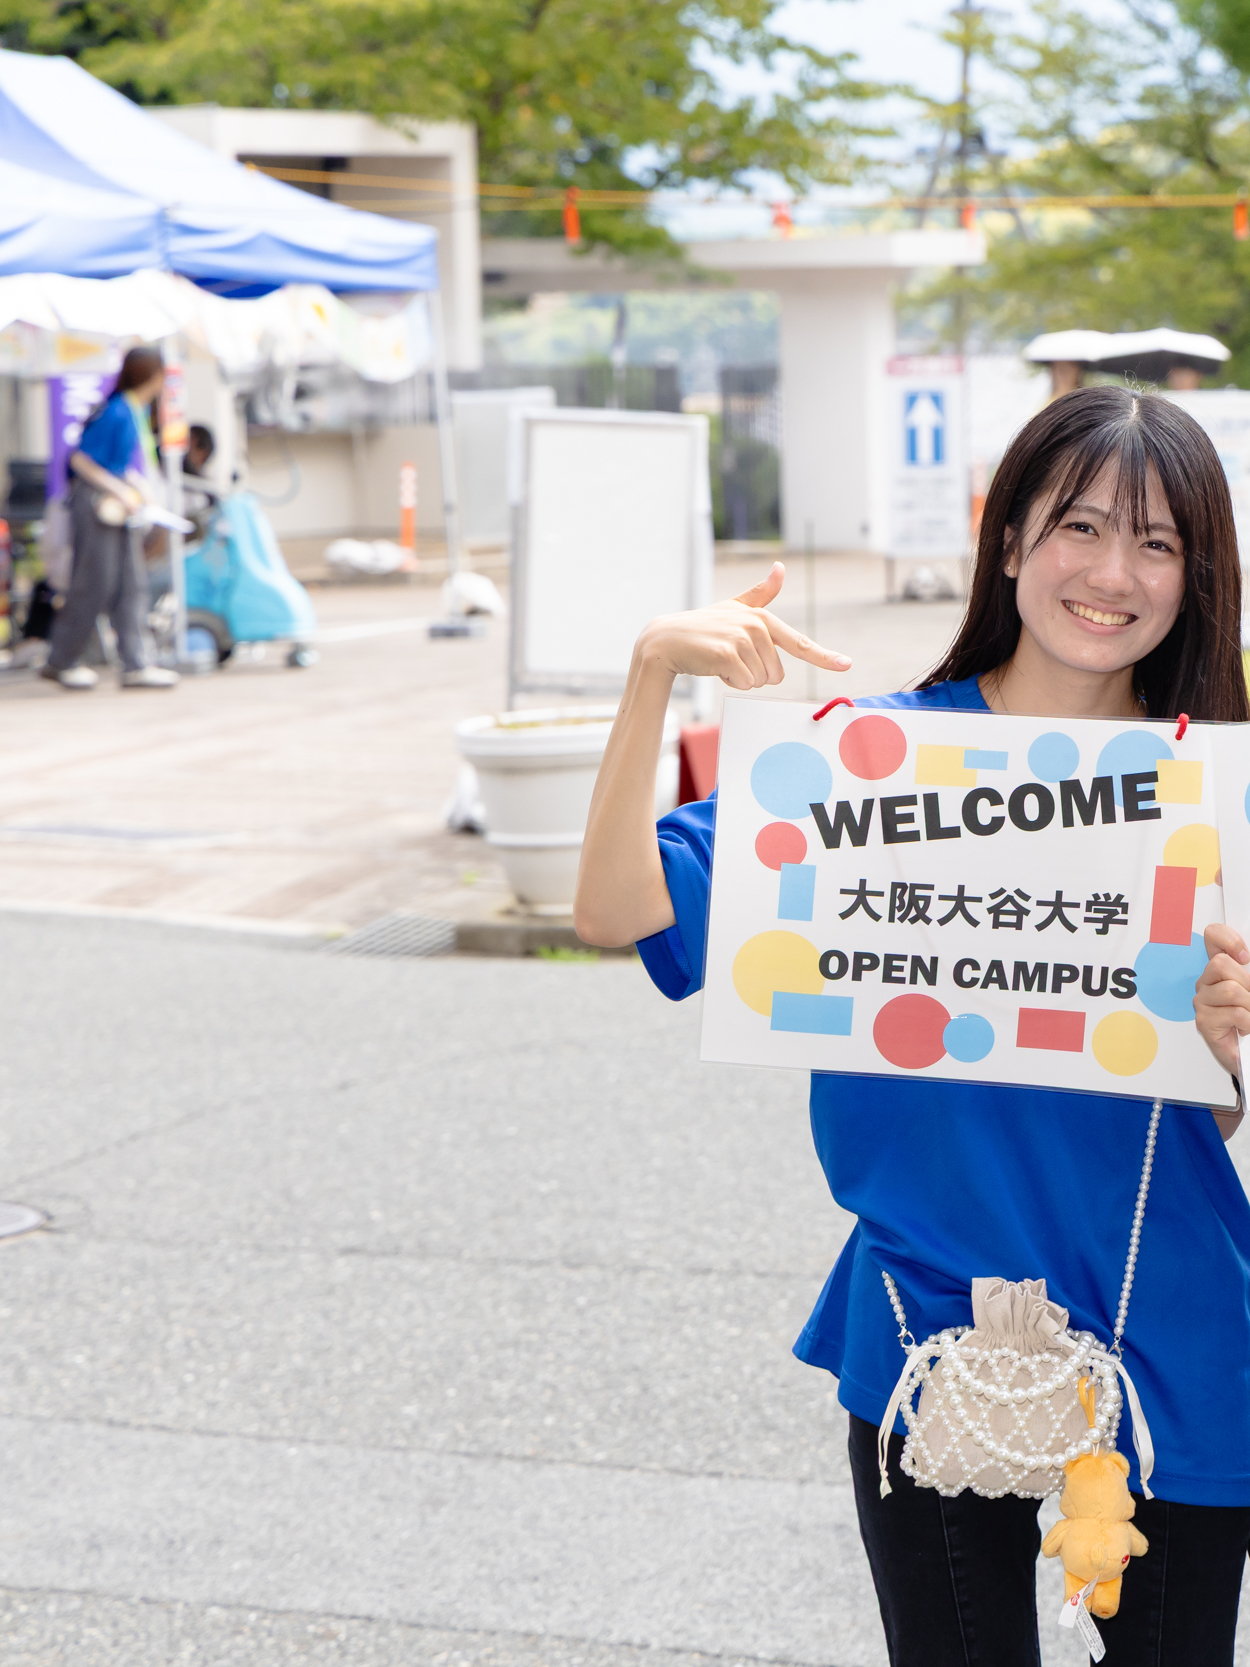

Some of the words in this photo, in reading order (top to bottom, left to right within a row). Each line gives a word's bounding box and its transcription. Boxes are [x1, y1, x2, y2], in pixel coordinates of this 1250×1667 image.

[809, 770, 1162, 849] WELCOME
[838, 878, 1130, 936] 大阪大谷大学
[818, 949, 939, 987] OPEN
[952, 957, 1137, 999] CAMPUS
